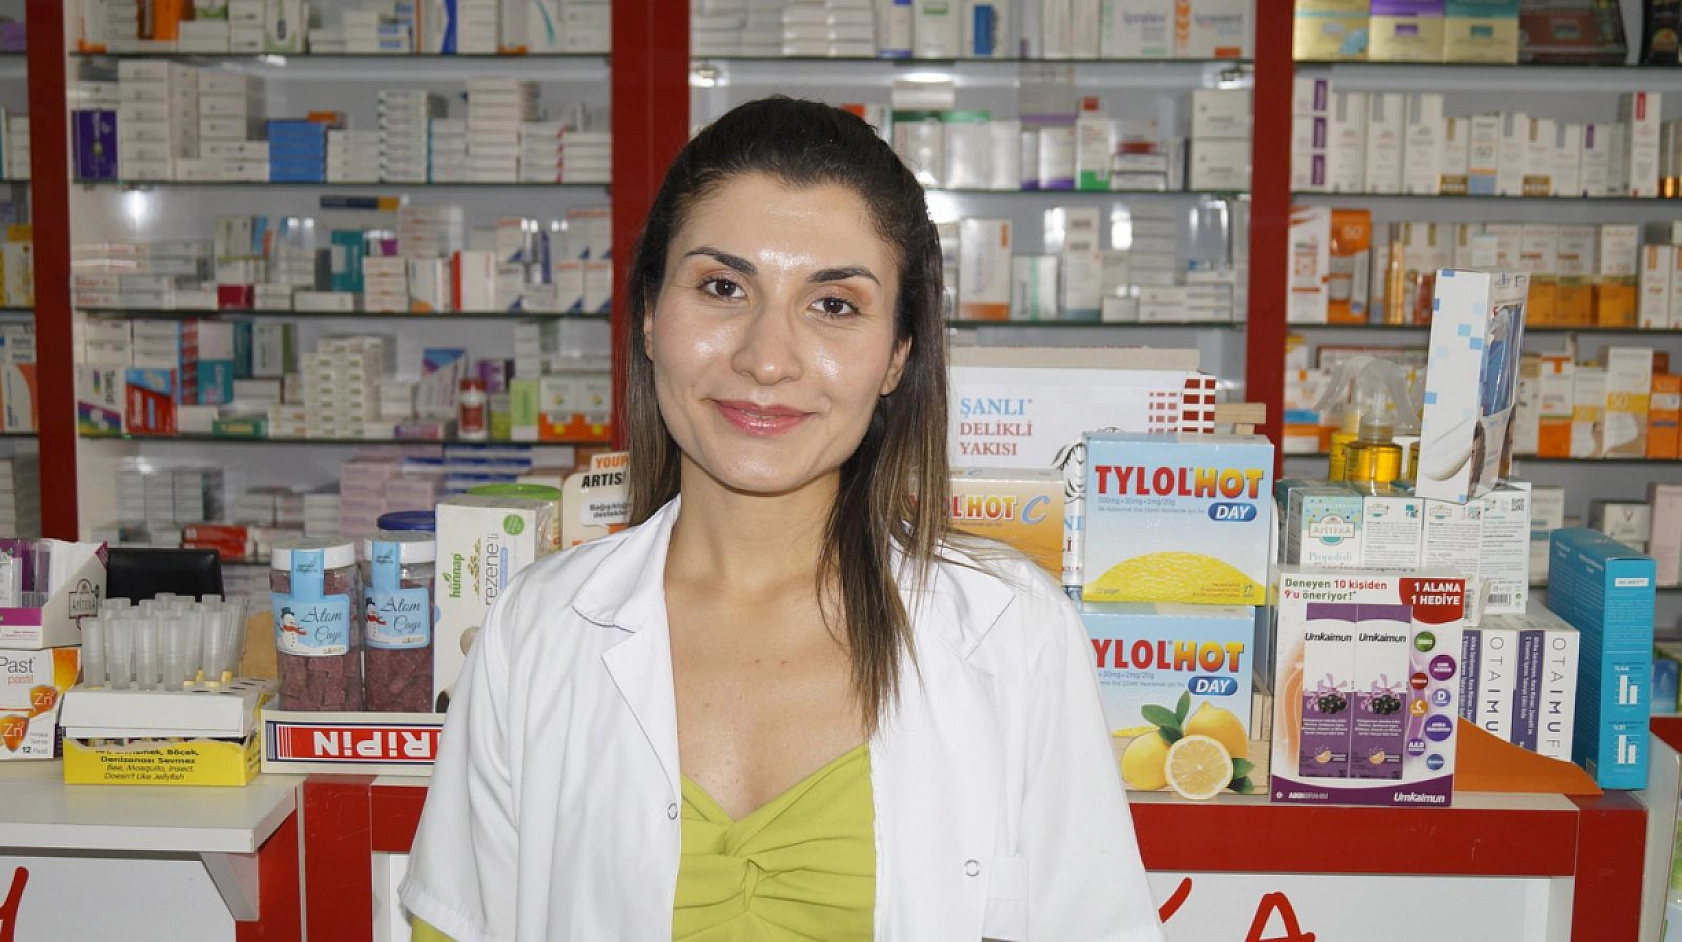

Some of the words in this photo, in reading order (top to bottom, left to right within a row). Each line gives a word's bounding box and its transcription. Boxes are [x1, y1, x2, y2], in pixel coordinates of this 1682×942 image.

[960, 398, 1026, 419] ŞANLI
[960, 420, 1032, 436] DELİKLİ
[960, 442, 1017, 456] YAKISI
[1021, 494, 1050, 525] C
[1215, 505, 1250, 520] DAY
[1285, 578, 1331, 589] Deneyen
[1334, 580, 1347, 588] 10
[1349, 580, 1388, 590] kişiden
[1414, 582, 1420, 591] 1
[1422, 582, 1462, 592] ALANA
[379, 597, 421, 612] Atom
[1411, 595, 1417, 604] 1
[1420, 593, 1461, 605] HEDİYE
[301, 607, 342, 623] Atom
[1091, 639, 1245, 673] YLOLHOT
[1196, 679, 1229, 693] DAY
[1546, 637, 1567, 757] OTAIMUF
[1394, 792, 1446, 803] Umkaimun
